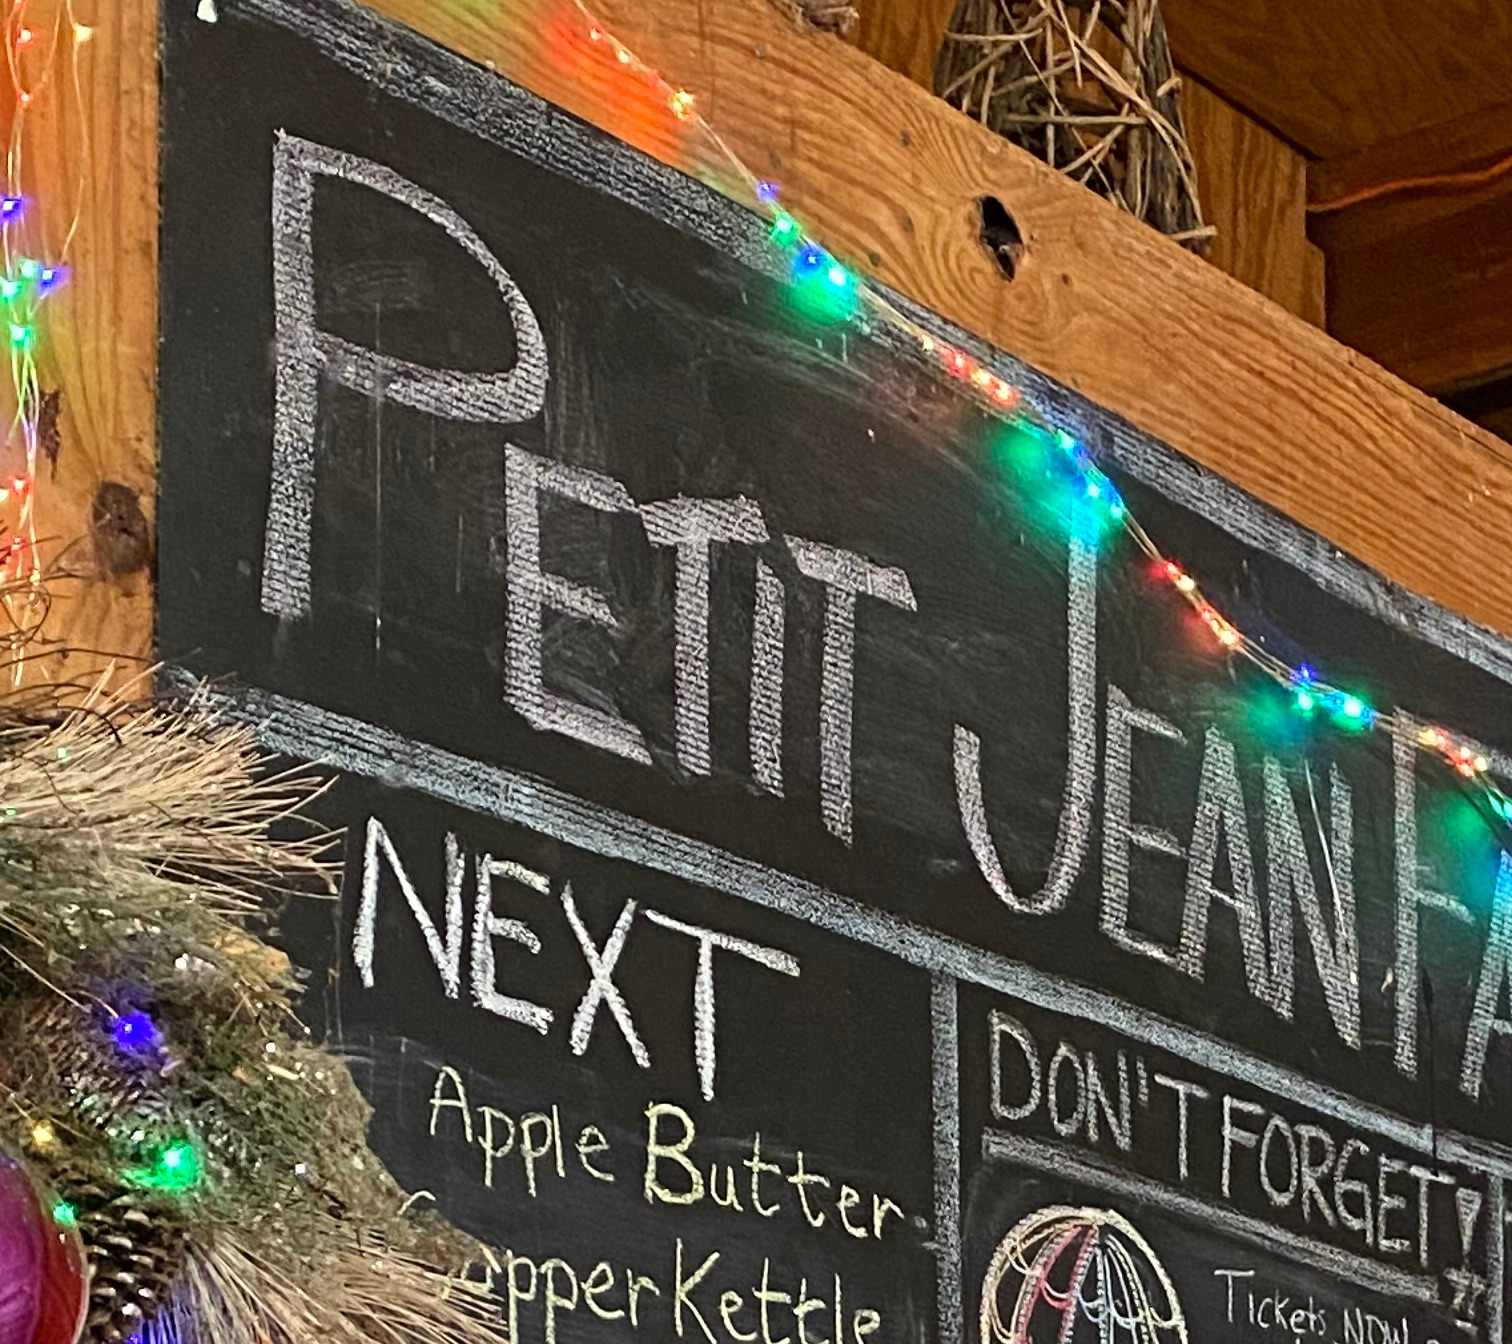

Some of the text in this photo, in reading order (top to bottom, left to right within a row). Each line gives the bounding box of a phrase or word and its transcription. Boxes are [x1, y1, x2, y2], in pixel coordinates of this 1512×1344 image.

[262, 129, 916, 845] PETIT
[953, 488, 1361, 1049] JEAN
[354, 817, 800, 1100] NEXT
[430, 1067, 904, 1239] Apple Butter
[989, 1008, 1209, 1182] DON'T
[1214, 1268, 1327, 1336] Tickets
